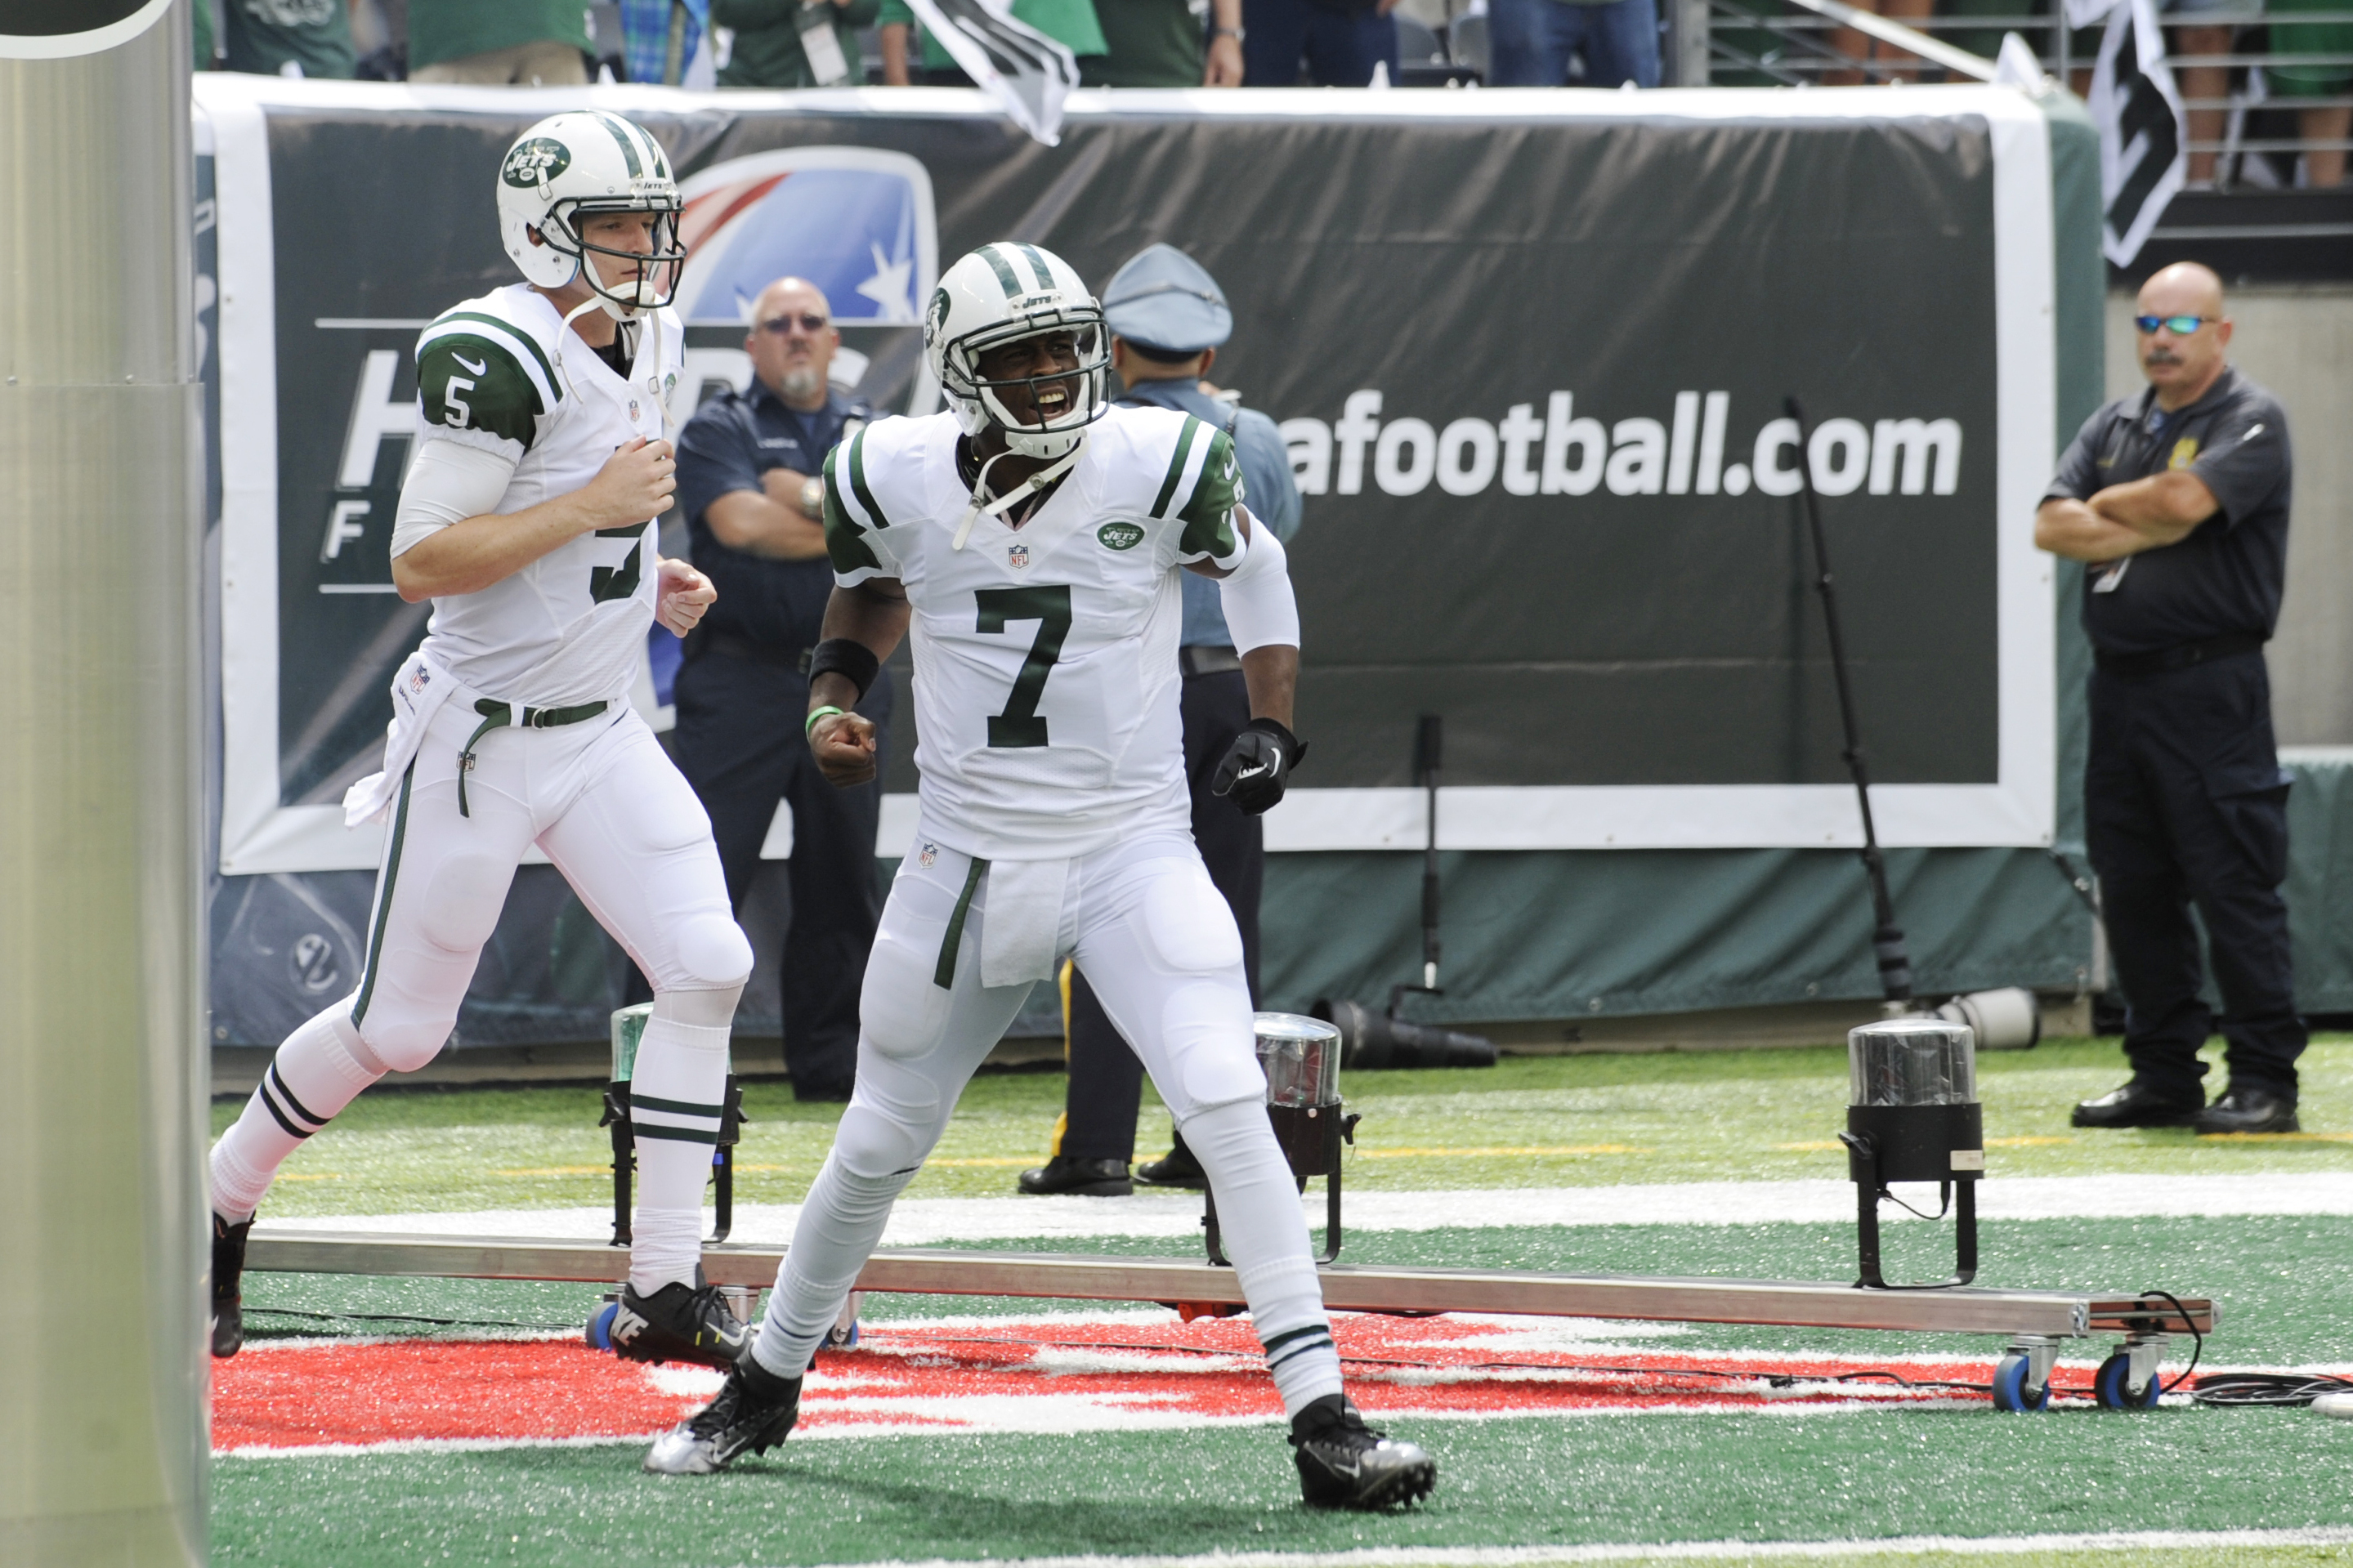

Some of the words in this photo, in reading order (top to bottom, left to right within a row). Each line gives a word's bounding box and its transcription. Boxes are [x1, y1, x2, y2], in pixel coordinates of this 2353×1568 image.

[507, 152, 557, 172] JETS
[1022, 295, 1051, 309] JETS
[445, 375, 476, 427] 5
[1277, 390, 1963, 497] afootball.com
[1103, 530, 1138, 540] JETS
[1011, 555, 1027, 565] NFL
[974, 584, 1072, 748] 7
[610, 1301, 650, 1347] KE
